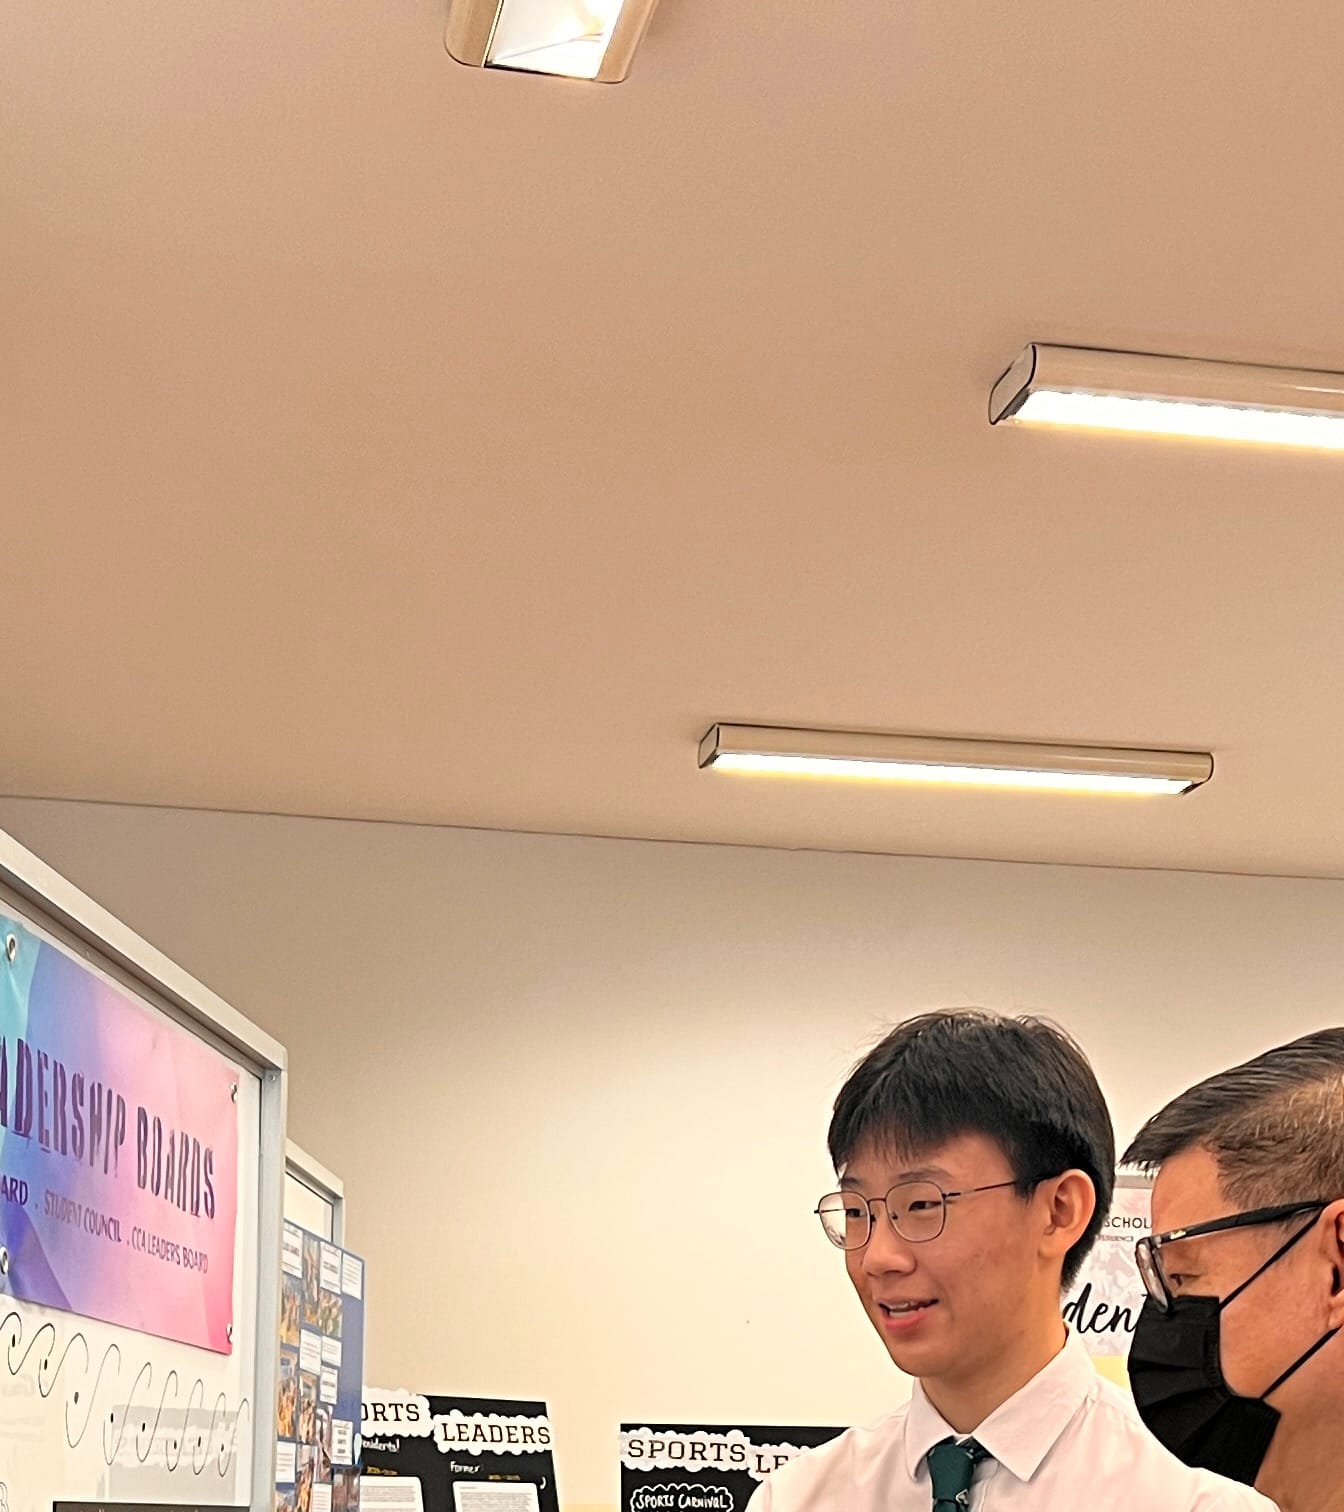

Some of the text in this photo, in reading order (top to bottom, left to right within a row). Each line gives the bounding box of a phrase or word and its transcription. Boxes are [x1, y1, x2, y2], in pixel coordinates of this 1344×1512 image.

[136, 1106, 216, 1221] BOARDS
[44, 1189, 84, 1229] STUDENT
[84, 1207, 122, 1243] COUNCIL
[131, 1226, 147, 1252] CCA
[148, 1231, 181, 1266] LEADERS
[183, 1247, 210, 1274] BOARD
[442, 1423, 551, 1445] LEADERS
[627, 1439, 746, 1463] SPORTS
[635, 1494, 675, 1508] SPORTS
